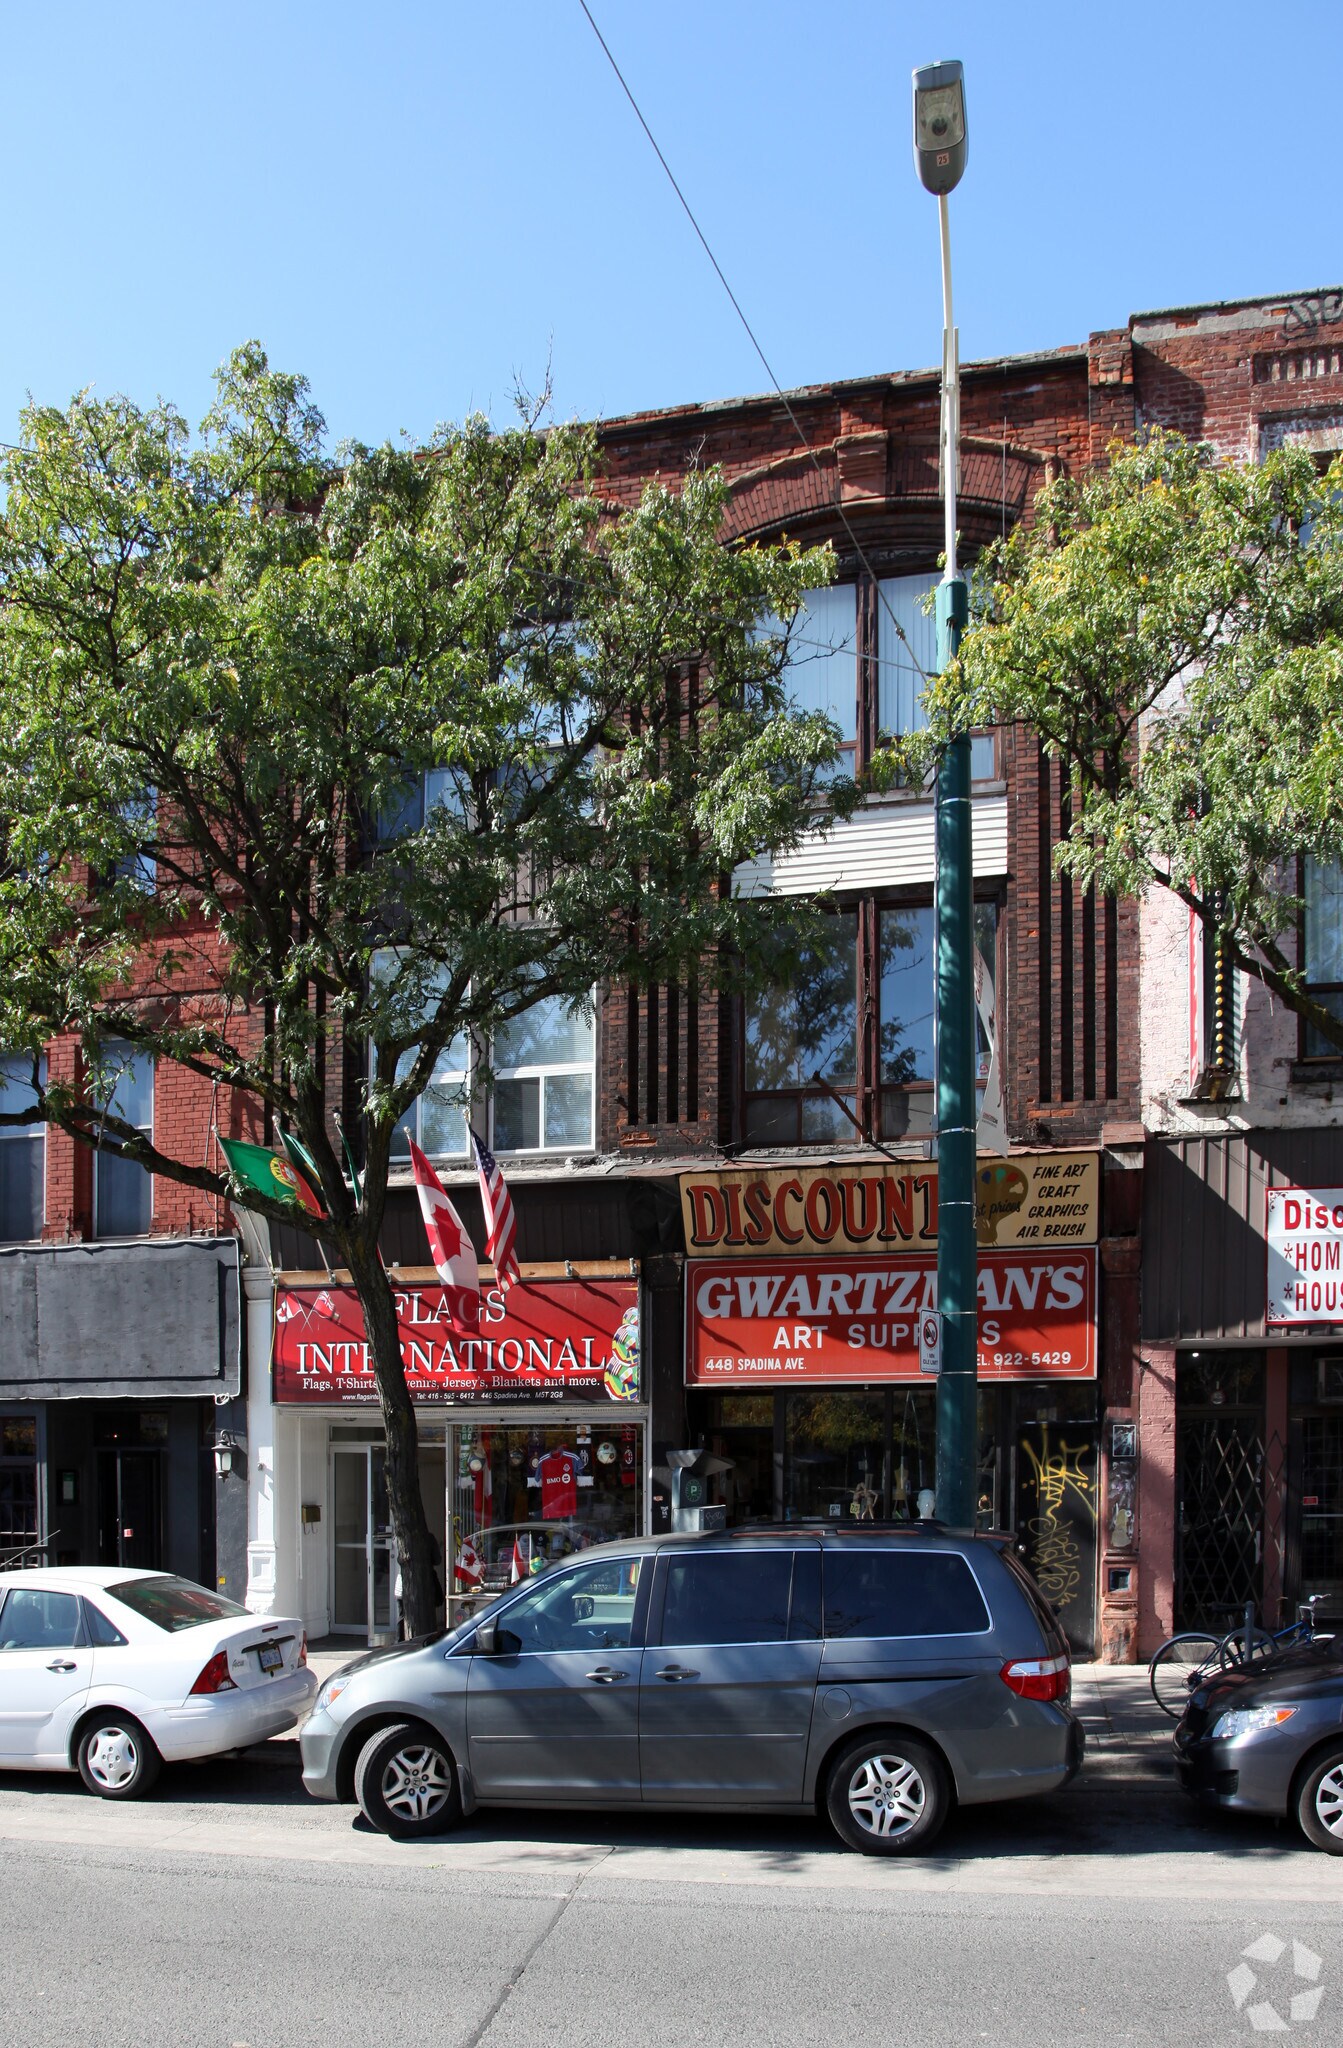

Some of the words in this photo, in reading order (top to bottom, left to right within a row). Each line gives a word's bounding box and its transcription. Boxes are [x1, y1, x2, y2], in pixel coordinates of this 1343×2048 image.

[1033, 1165, 1062, 1179] FINE
[1063, 1164, 1089, 1178] ART
[1038, 1185, 1080, 1198] CRAFT
[686, 1174, 938, 1247] DISCOUNT
[1028, 1204, 1089, 1218] GRAPHICS
[1016, 1225, 1040, 1238] AIR
[1043, 1223, 1086, 1237] BRUSH
[773, 1326, 828, 1349] ART
[847, 1320, 1001, 1349] SUPS
[296, 1337, 606, 1375] INTENATIONAL
[977, 1353, 990, 1366] EL.
[993, 1352, 1071, 1366] 922-5429
[705, 1359, 733, 1371] 448
[738, 1358, 781, 1370] SPADINA
[784, 1358, 807, 1370] AVE.
[303, 1377, 333, 1391] Flags,
[442, 1376, 488, 1390] Jersey's,
[492, 1376, 541, 1387] Blankets
[544, 1375, 565, 1386] and
[568, 1377, 600, 1387] more.
[494, 1391, 518, 1399] Spadina
